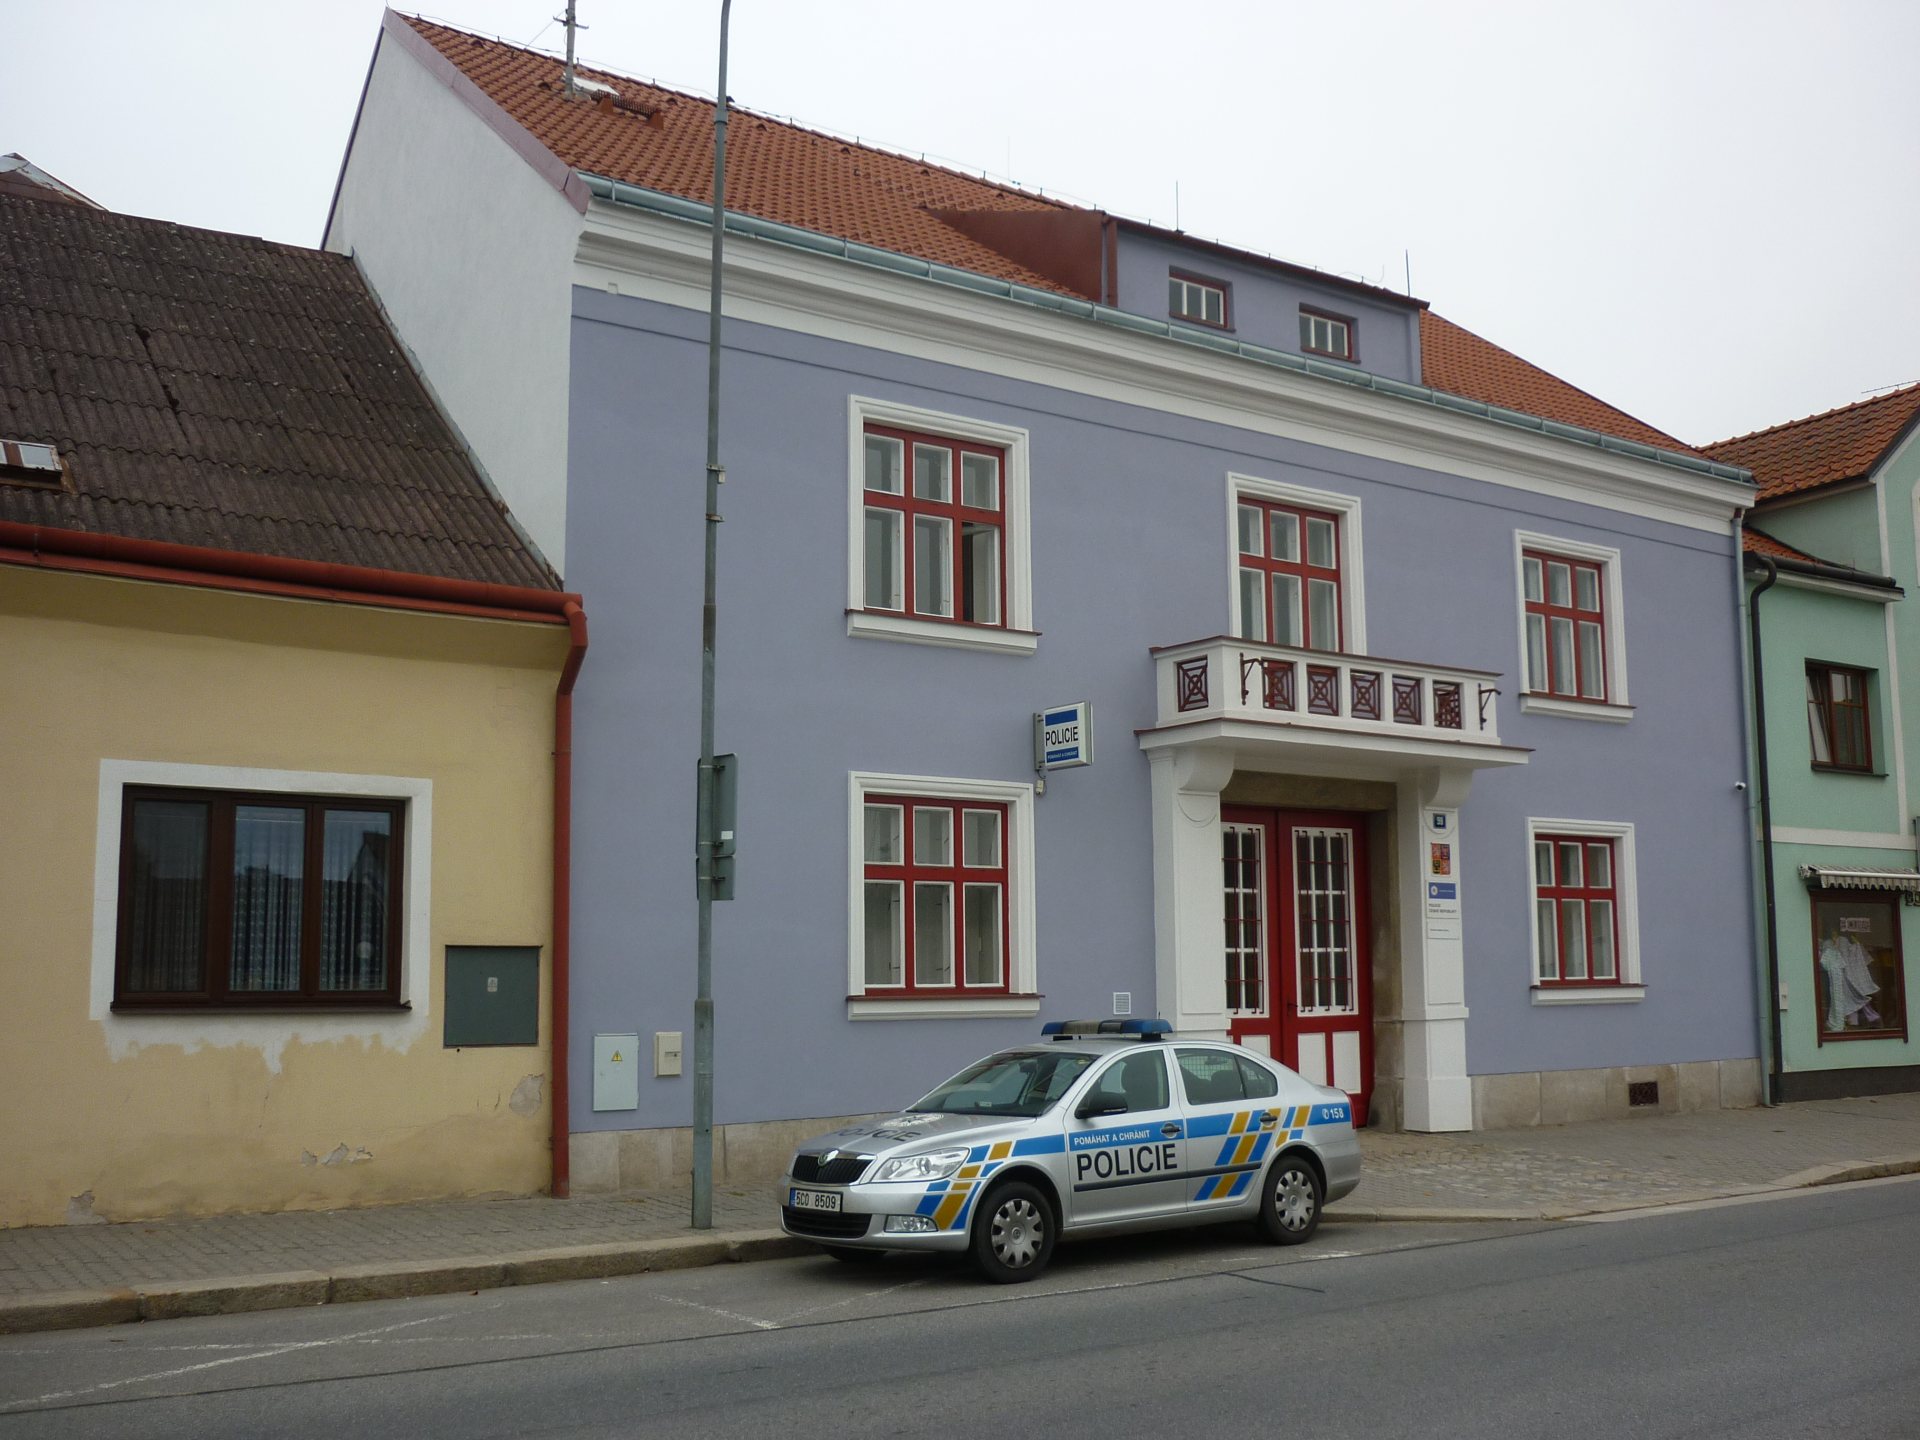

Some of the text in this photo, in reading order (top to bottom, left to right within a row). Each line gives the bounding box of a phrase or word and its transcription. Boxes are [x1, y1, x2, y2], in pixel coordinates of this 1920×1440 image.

[1045, 726, 1079, 747] POLICIE
[1330, 1107, 1344, 1119] 158
[829, 1128, 922, 1142] OLICIE
[1074, 1129, 1151, 1146] POMÁHAT A CHRÁNIT
[1076, 1143, 1178, 1181] POLICIE
[814, 1194, 837, 1209] 8509
